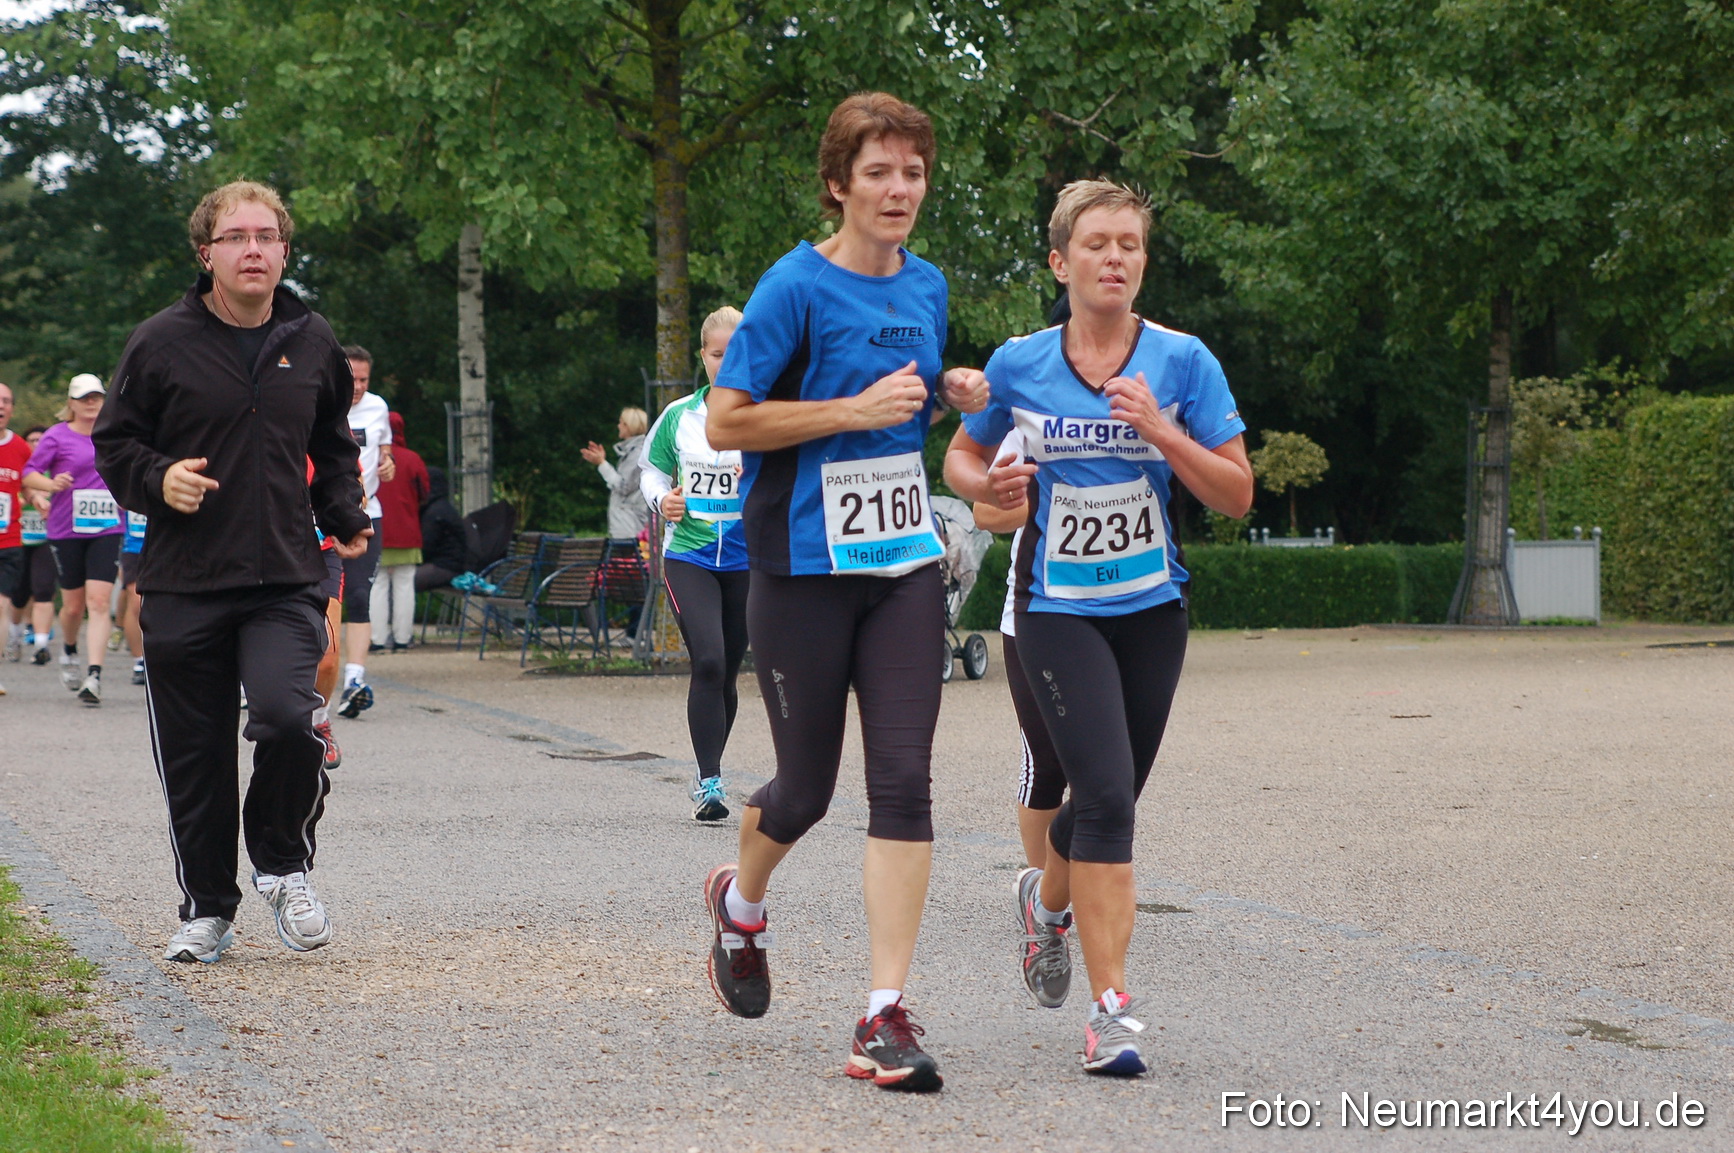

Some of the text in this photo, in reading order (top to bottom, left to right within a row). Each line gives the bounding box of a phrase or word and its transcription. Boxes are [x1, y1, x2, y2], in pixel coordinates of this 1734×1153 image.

[879, 326, 925, 338] ERTEL
[1043, 417, 1139, 444] Margra
[1044, 443, 1149, 455] Bauunternehmen
[685, 460, 706, 470] PARTL
[690, 471, 739, 495] 279
[826, 468, 914, 487] PARTL Neumarkt
[79, 500, 113, 516] 2044
[707, 501, 727, 512] Lina
[840, 484, 922, 536] 2160
[1054, 493, 1142, 510] PARTL Neumarkt
[1058, 505, 1155, 557] 2234
[847, 541, 929, 565] Heidemarie
[1096, 564, 1120, 582] Evi
